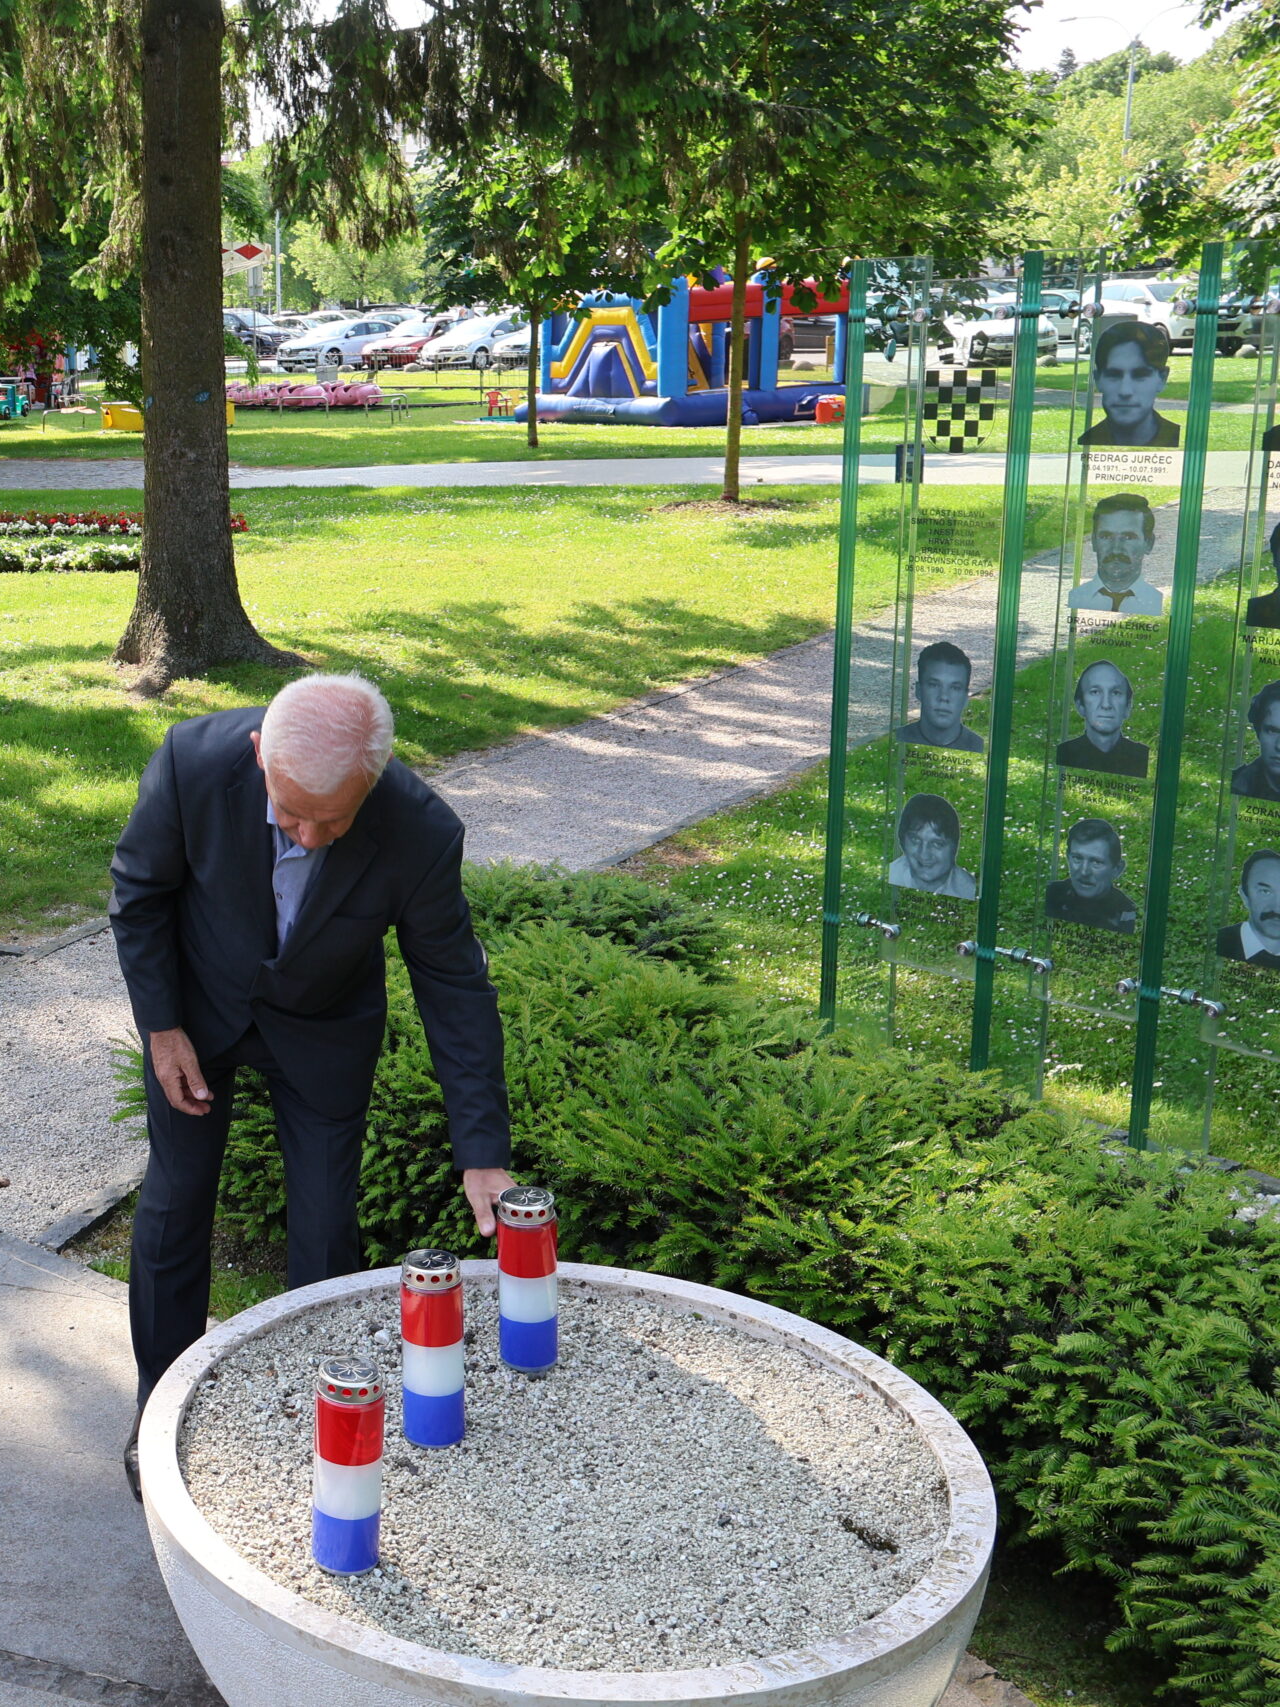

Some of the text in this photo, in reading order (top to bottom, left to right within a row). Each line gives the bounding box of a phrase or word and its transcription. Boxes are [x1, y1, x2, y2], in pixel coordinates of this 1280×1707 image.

[1080, 453, 1173, 465] PREDRAG JURČEC
[1094, 473, 1154, 483] PRINCIPOVAC
[909, 555, 994, 567] DOMOVINSKOG RATA
[1066, 615, 1117, 628] DRAGUTIN
[1090, 637, 1132, 647] VUKOVAR
